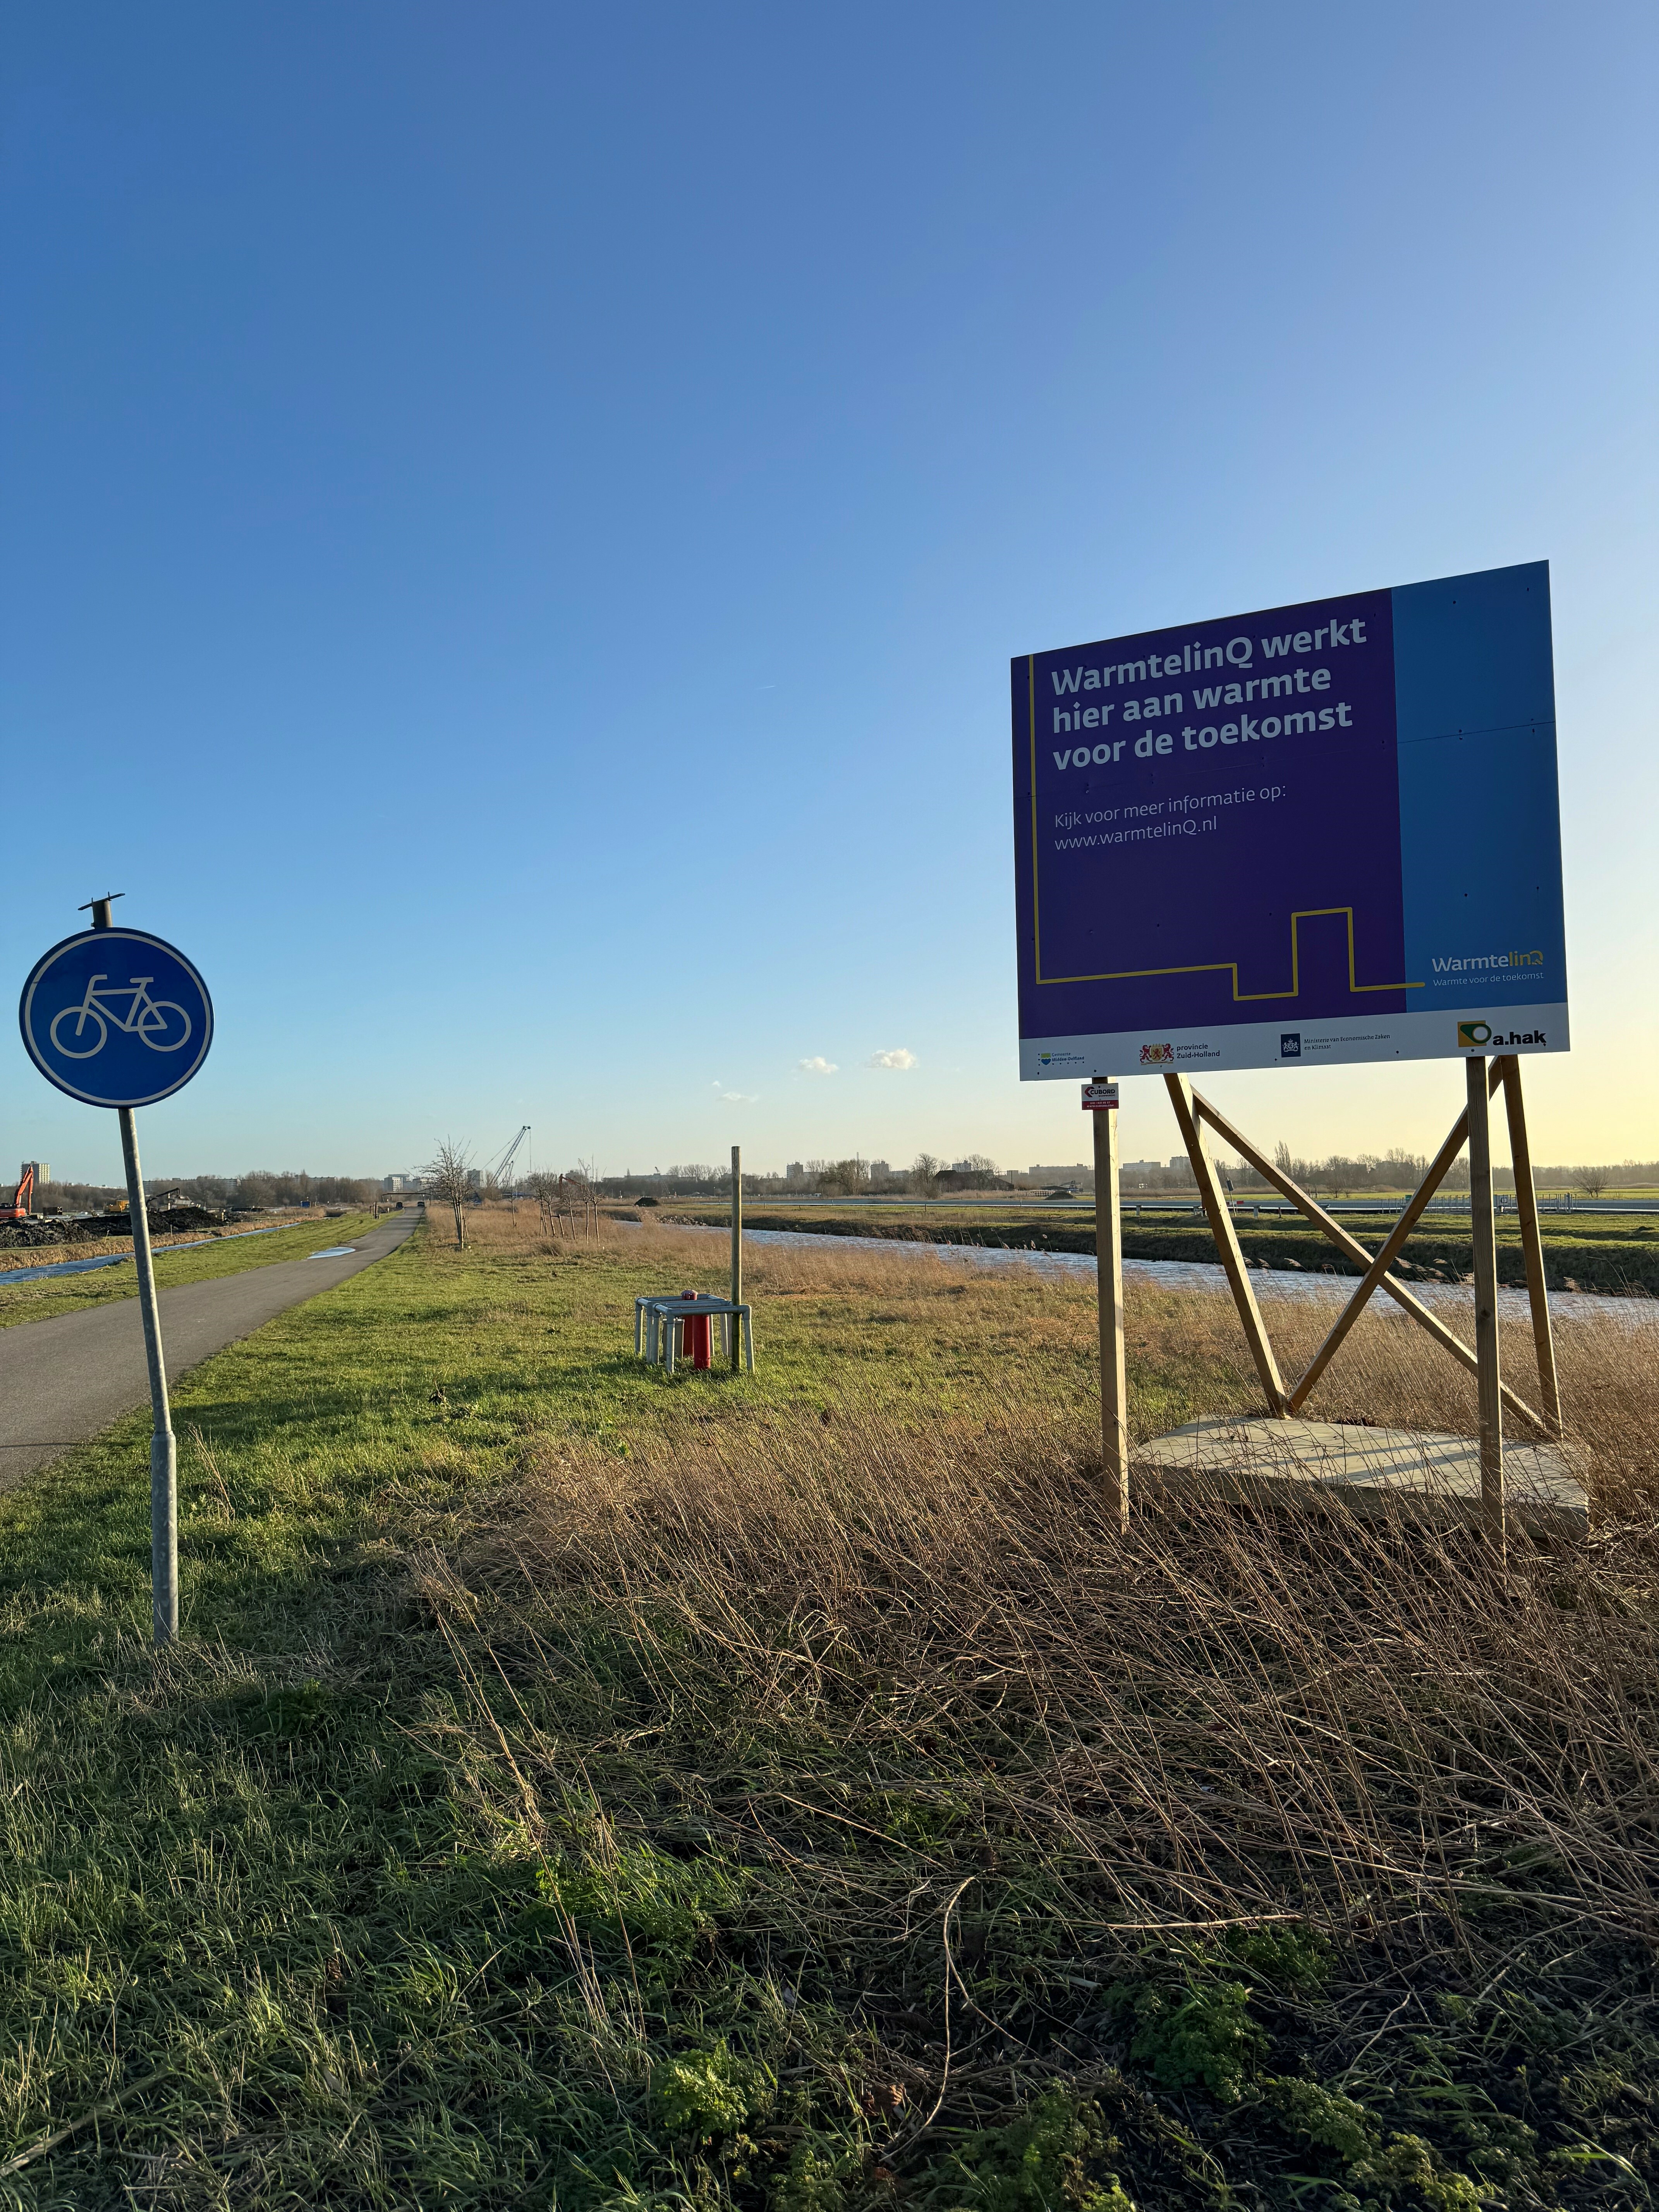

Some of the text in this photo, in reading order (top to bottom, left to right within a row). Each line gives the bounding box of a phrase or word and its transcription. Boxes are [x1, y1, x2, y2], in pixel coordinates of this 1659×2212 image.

[1052, 619, 1367, 696] WarmtelinQ werkt
[1053, 669, 1331, 733] hier aan warmte
[1053, 702, 1353, 770] voor de toekomst
[1055, 786, 1287, 830] Kijk voor meer informatie op:
[1054, 816, 1217, 850] www.warmtelinQ.nl
[1432, 950, 1544, 972] WarmtelinQ
[1433, 977, 1467, 986] Warmte
[1503, 972, 1544, 981] toekomst
[1177, 1043, 1208, 1051] provincie
[1493, 1030, 1546, 1046] a.hak
[1177, 1050, 1220, 1059] Zuid-Holland
